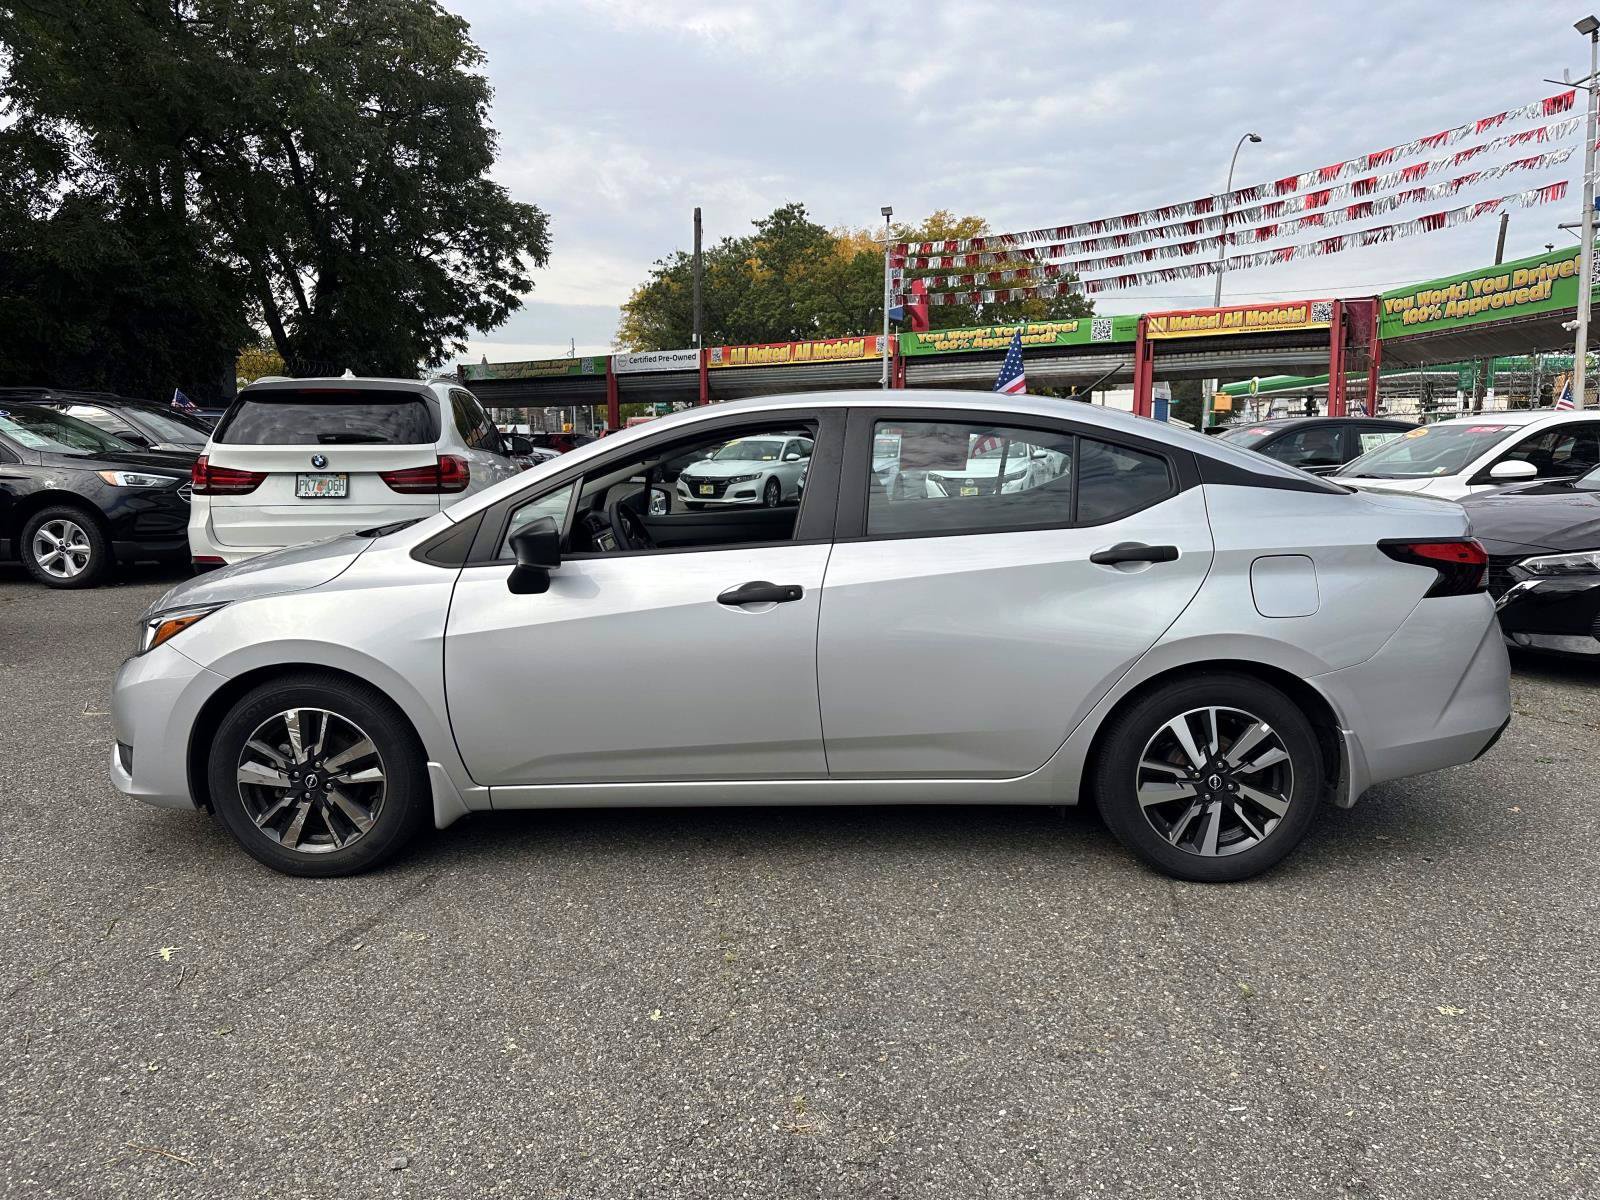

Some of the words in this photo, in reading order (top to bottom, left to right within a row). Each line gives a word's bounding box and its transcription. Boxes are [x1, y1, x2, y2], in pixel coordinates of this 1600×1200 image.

[1383, 294, 1415, 315] You
[1416, 281, 1469, 308] Work!
[1470, 274, 1510, 297] You
[1402, 303, 1443, 325] 100%
[1444, 279, 1553, 319] Approved!
[916, 332, 945, 344] You
[947, 327, 992, 341] Work!
[1027, 321, 1080, 335] Drive!
[1147, 316, 1168, 333] All
[1169, 312, 1221, 333] Makes!
[1221, 311, 1244, 328] All
[1245, 306, 1307, 327] Models!
[729, 347, 746, 365] All
[747, 344, 791, 364] Makes!
[794, 342, 812, 361] All
[812, 339, 865, 360] Models!
[933, 339, 970, 352] 100%
[972, 332, 1058, 350] Apprved!
[629, 355, 657, 364] Certified
[658, 353, 697, 362] Pre-Owned
